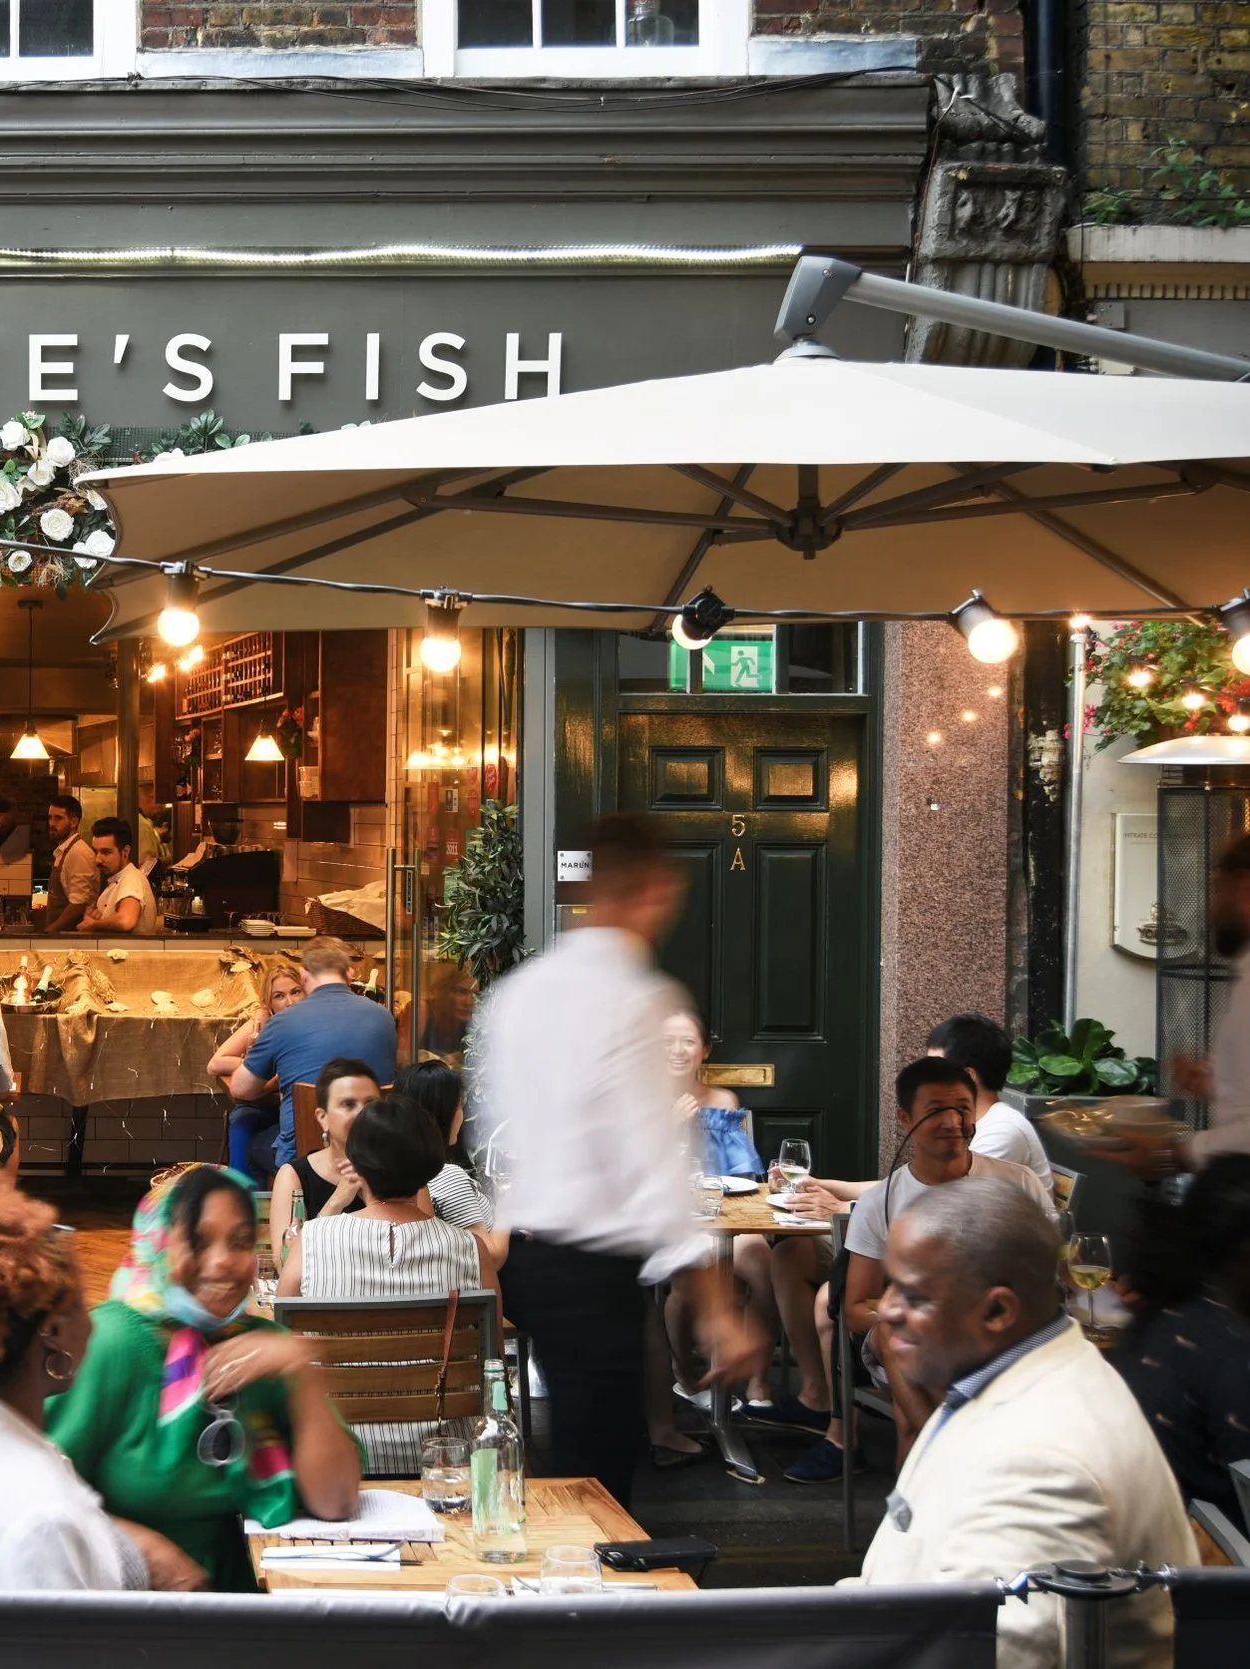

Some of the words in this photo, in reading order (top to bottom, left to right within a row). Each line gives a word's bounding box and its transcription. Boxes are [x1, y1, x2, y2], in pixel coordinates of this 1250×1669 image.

[278, 332, 563, 401] FISH
[731, 815, 746, 837] 5
[730, 848, 746, 871] A
